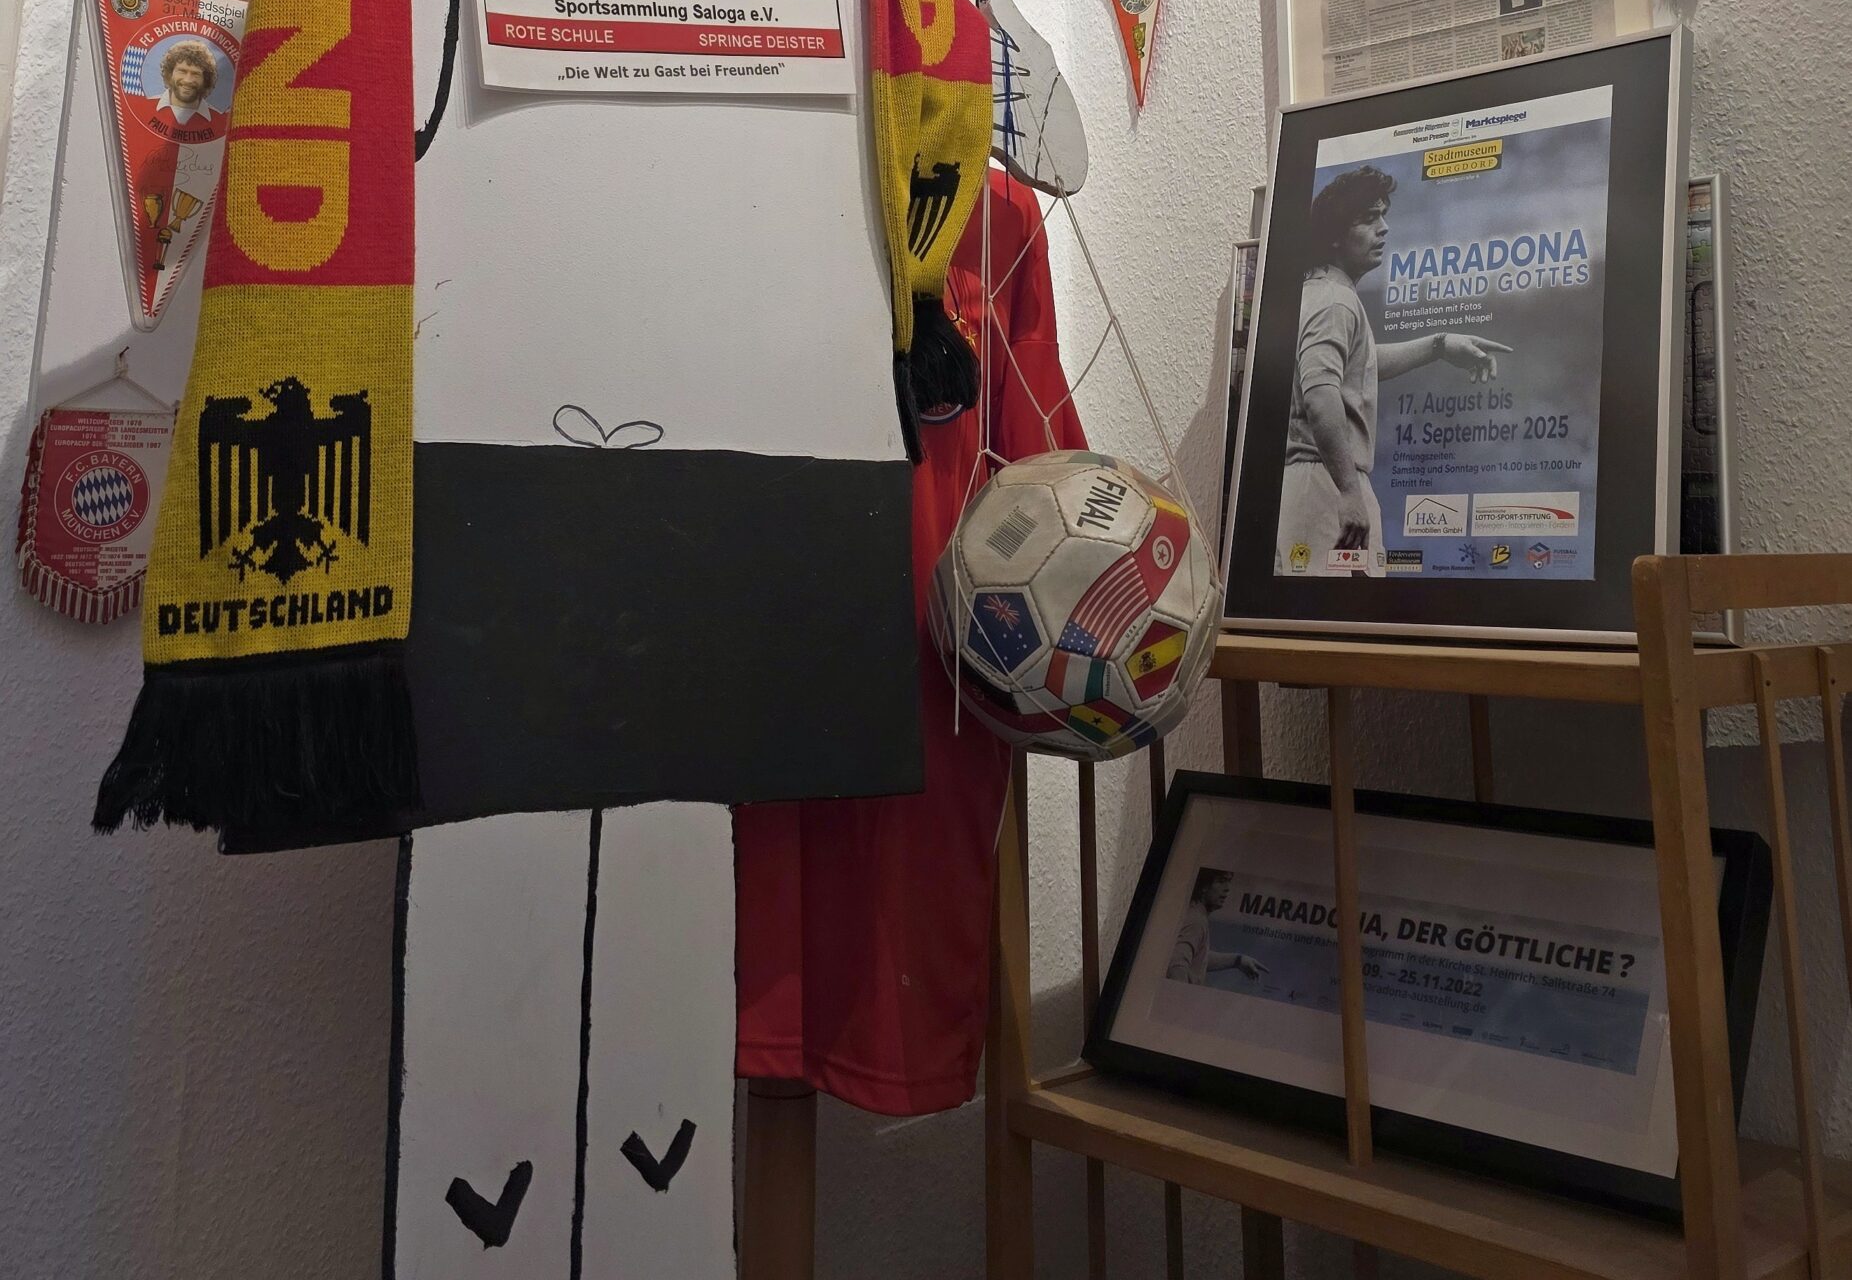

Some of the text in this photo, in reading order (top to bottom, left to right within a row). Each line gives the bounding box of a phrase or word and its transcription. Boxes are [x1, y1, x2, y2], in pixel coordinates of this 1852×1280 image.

[162, 3, 234, 29] 31. Mai 1983
[692, 3, 746, 23] Saloga
[750, 7, 780, 22] e.V.
[138, 21, 241, 64] FC BAYERN MÜNCHE
[504, 23, 825, 50] ROTE SCHULE SPRINGE DEISTER
[594, 65, 629, 79] Welt
[633, 67, 650, 79] zu
[654, 64, 686, 79] Gast
[690, 63, 711, 78] bei
[148, 116, 215, 142] PAUL BREITNER
[1465, 111, 1527, 129] Marktspiegel
[1412, 131, 1450, 144] Neue Presse
[1428, 144, 1497, 163] Stadtmuseum
[1430, 159, 1494, 176] BURGDORF
[1389, 228, 1588, 282] MARADONA
[1387, 263, 1590, 304] DIE HAND GOTTES
[1384, 302, 1482, 319] Eine Installation mit Fotos
[1384, 312, 1493, 331] von Sergio Siano aus Neapel
[1398, 387, 1513, 418] 17. August bis
[1395, 415, 1569, 449] 14. September 2025
[66, 454, 143, 485] F.C. BAYERN
[1392, 450, 1456, 463] Öffnungszeiten:
[1392, 465, 1426, 476] Samstag
[1428, 465, 1443, 473] und
[1445, 464, 1479, 475] Sonntag
[1499, 462, 1522, 471] 14.00
[1524, 461, 1537, 471] bis
[1540, 461, 1563, 470] 17.00
[1565, 460, 1582, 470] Uhr
[1391, 478, 1433, 488] Eintritt frei
[1076, 476, 1127, 531] FINAL
[60, 506, 120, 540] MÜNCHEN
[1415, 512, 1448, 525] H&A
[1475, 513, 1552, 521] LOTTO-SPORT-STIFTUNG
[1408, 526, 1463, 535] Immobilien GmbH
[158, 586, 394, 636] DEUTSCHLAND
[1239, 892, 1635, 978] MARADA, DER GÖTTLICHE ?
[1243, 924, 1292, 942] Installation
[1293, 933, 1313, 945] und
[1406, 951, 1417, 962] in
[1418, 955, 1438, 967] der
[1439, 957, 1472, 973] Kirche
[1473, 963, 1487, 976] St.
[1601, 986, 1616, 998] 74
[1398, 969, 1483, 997] 25.11.2022
